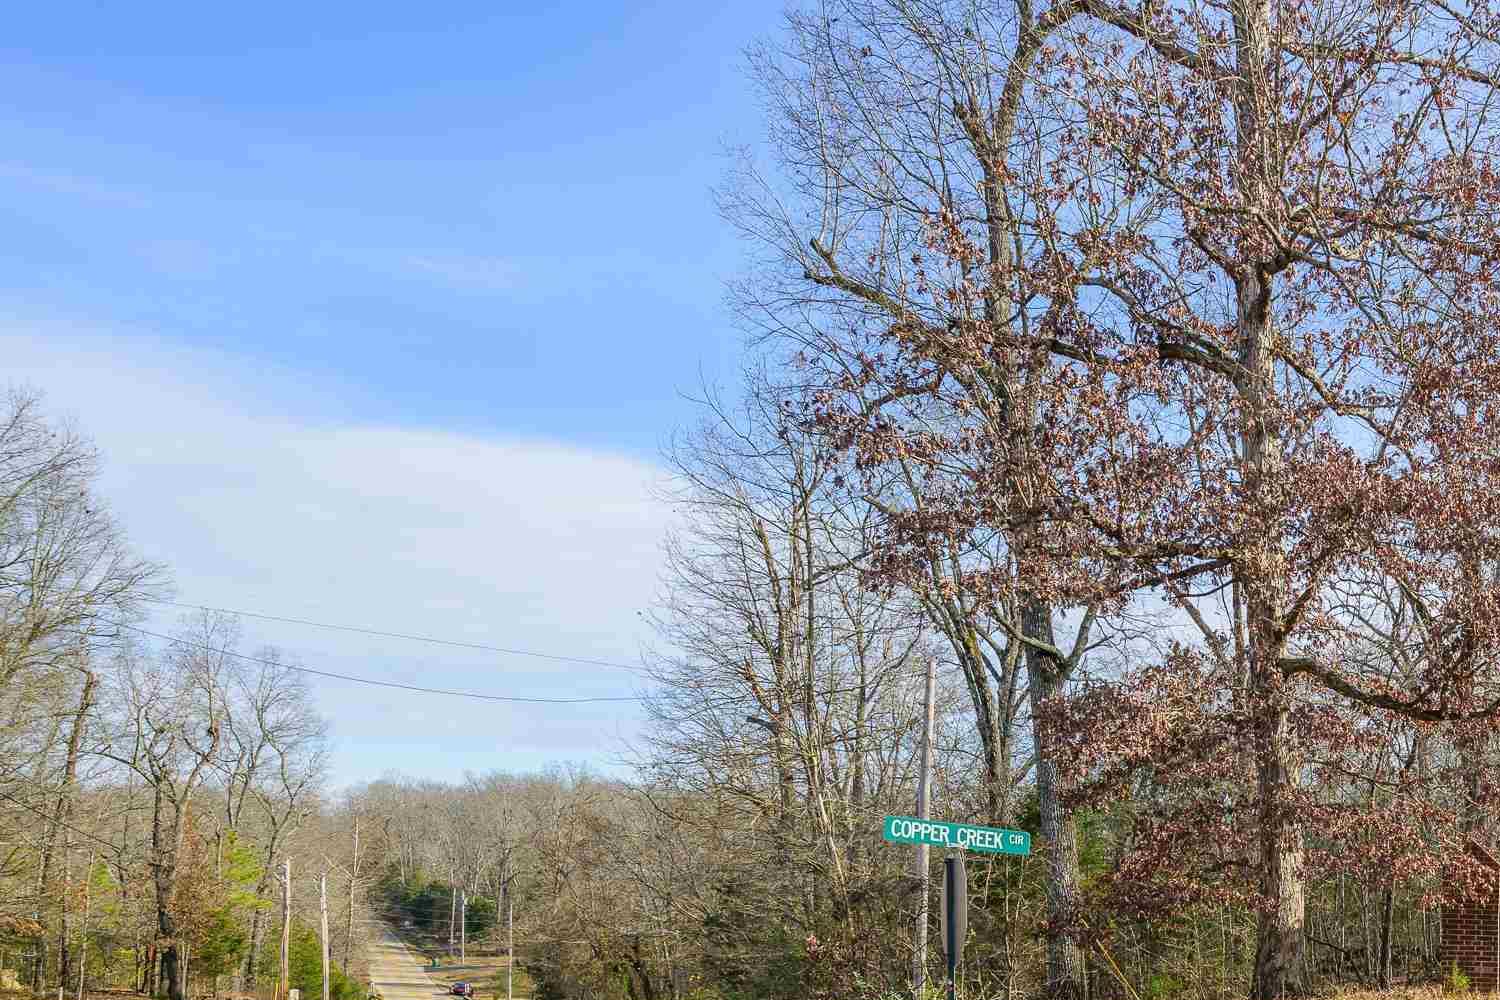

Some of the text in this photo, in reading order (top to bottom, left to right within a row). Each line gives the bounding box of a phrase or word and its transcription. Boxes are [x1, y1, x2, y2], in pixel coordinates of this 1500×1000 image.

[891, 819, 1024, 849] COPPER CREEK CIR
